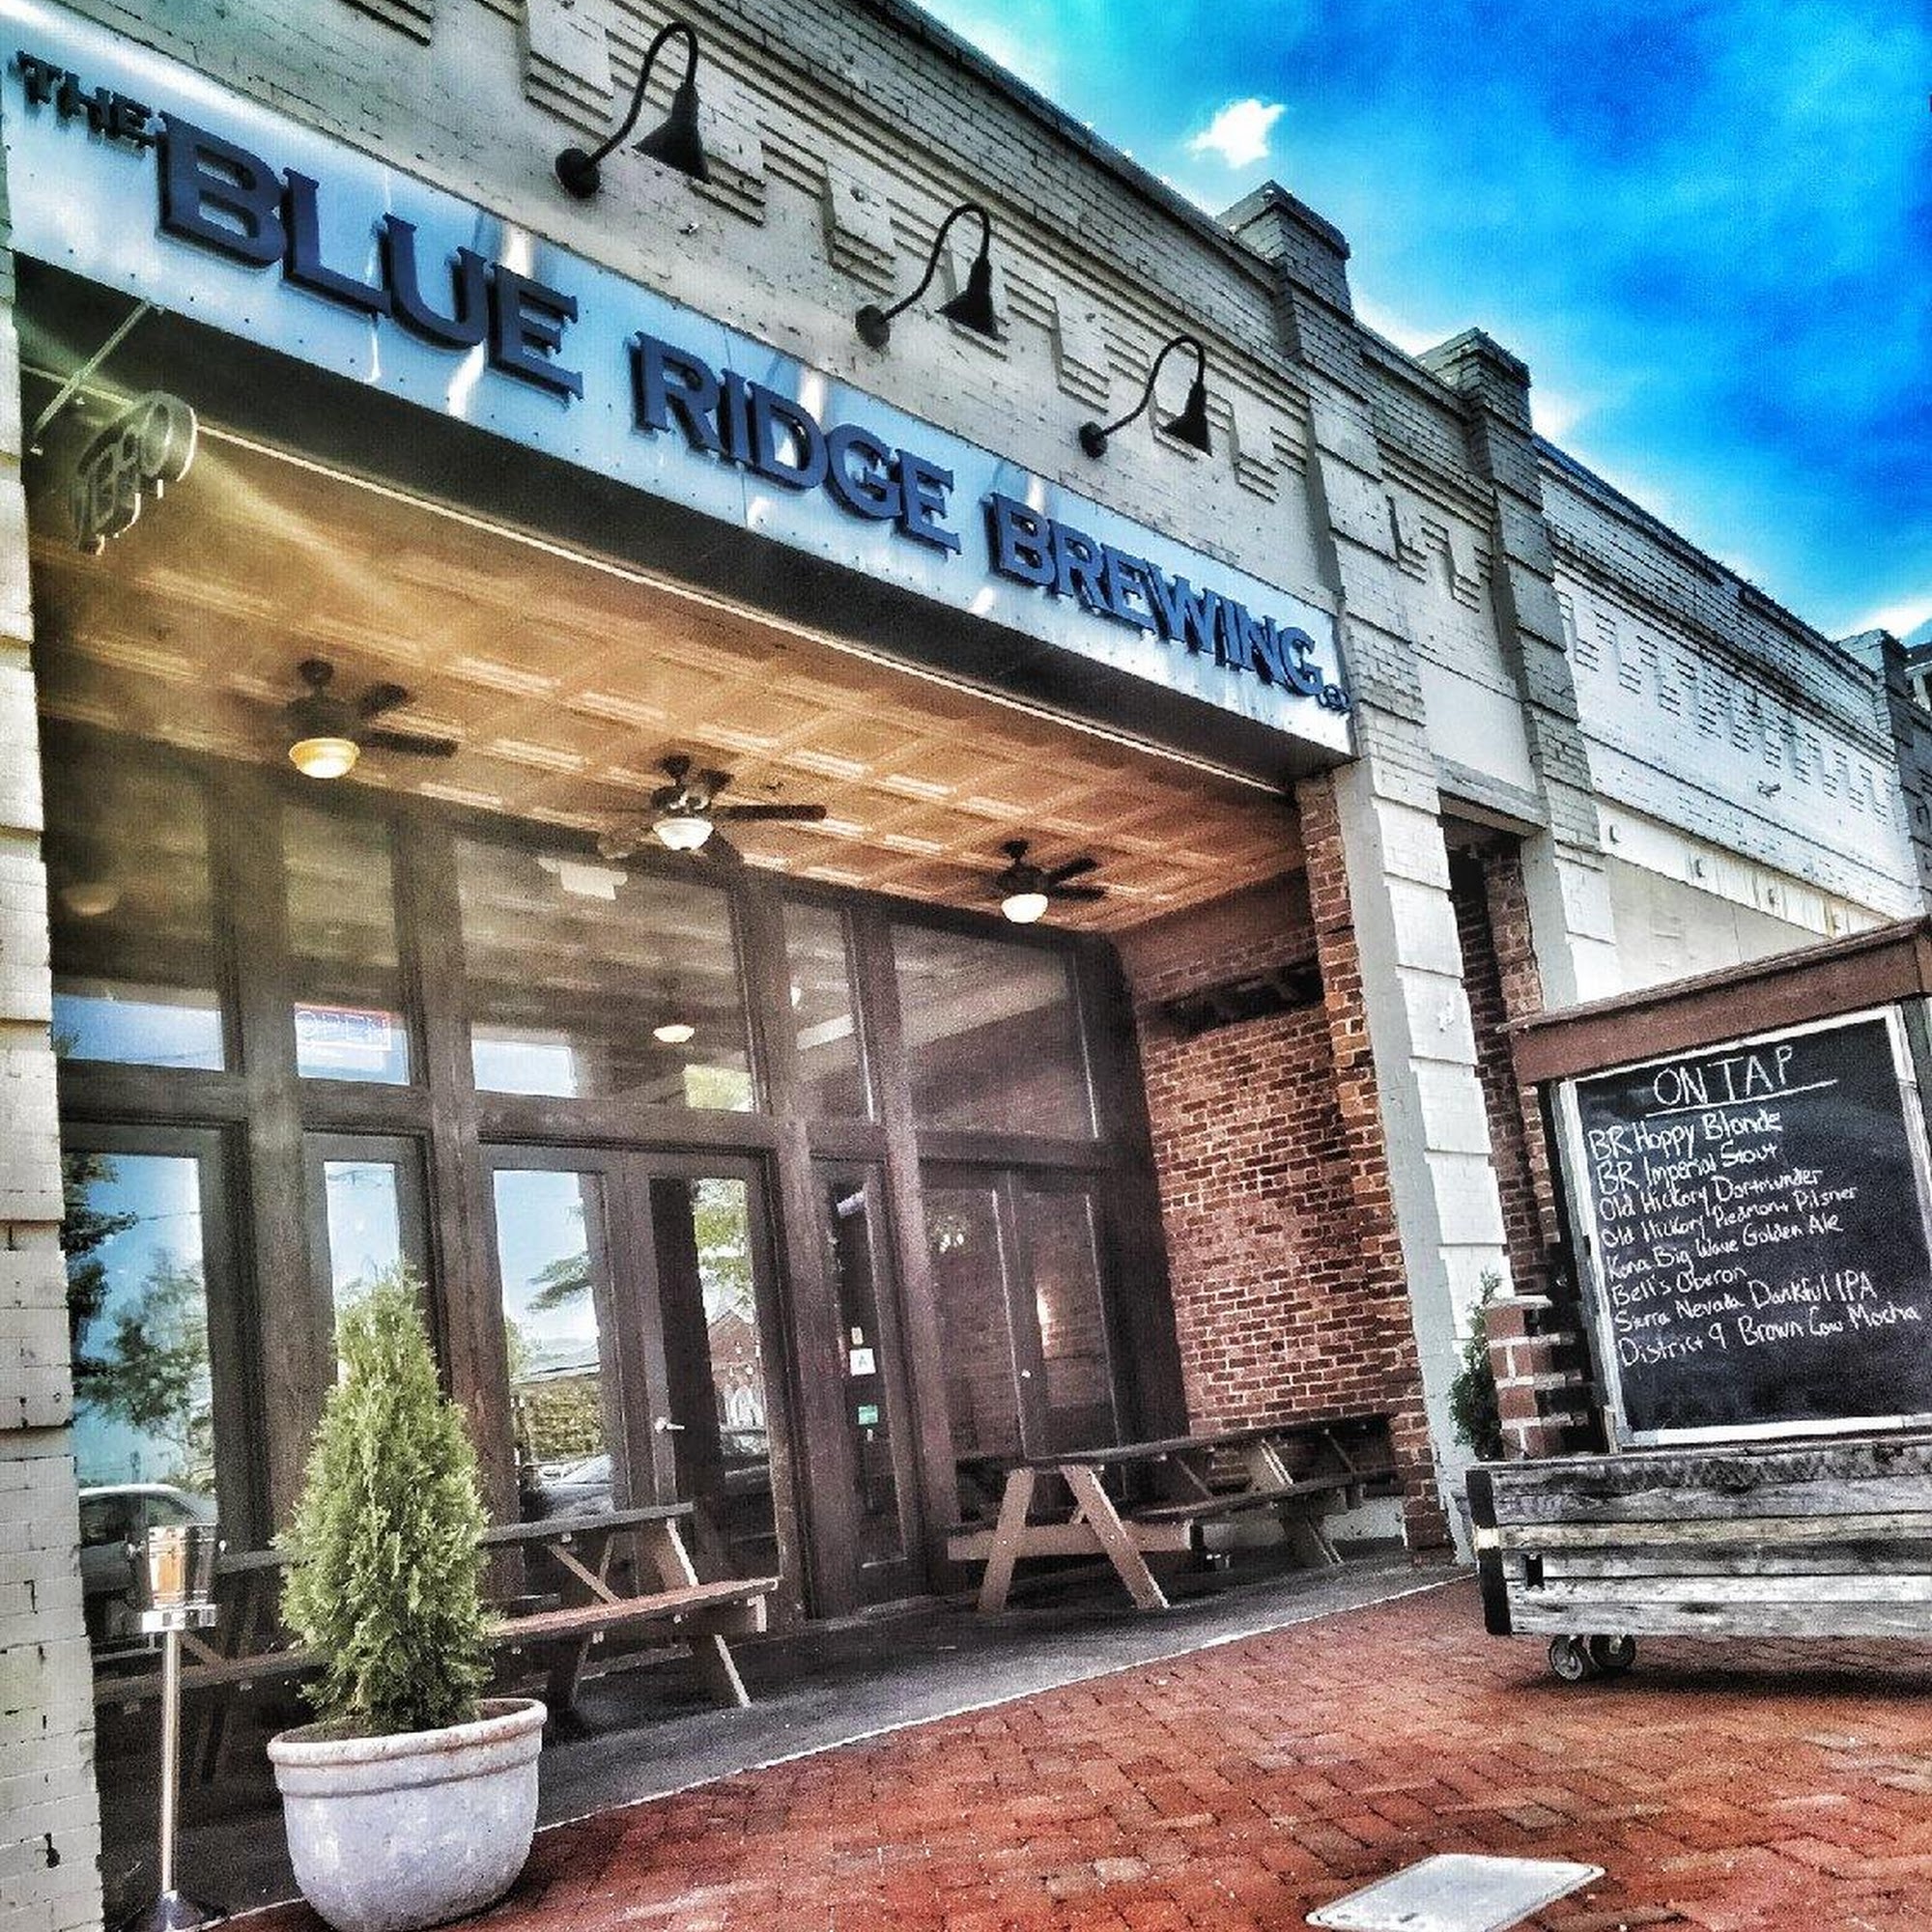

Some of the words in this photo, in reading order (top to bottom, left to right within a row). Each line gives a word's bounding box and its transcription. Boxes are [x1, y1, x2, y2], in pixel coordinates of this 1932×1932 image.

[15, 49, 156, 149] THE
[158, 111, 583, 401] BLUE
[632, 331, 961, 556] RIDGE
[982, 492, 1324, 696] BREWING
[1653, 1066, 1708, 1105] ON
[1706, 1044, 1793, 1101] TAP
[1588, 1124, 1634, 1160] BR
[1632, 1120, 1694, 1159] Hoppy
[1702, 1109, 1783, 1141] Blonde
[1596, 1159, 1639, 1196] BR
[1643, 1152, 1717, 1191] Imperial
[1719, 1138, 1778, 1168] Stout
[1600, 1193, 1636, 1221] Old
[1640, 1187, 1710, 1217] Hickory
[1601, 1226, 1634, 1248] Old
[1640, 1214, 1706, 1243] Hickory
[1712, 1201, 1789, 1229] Piedmont
[1792, 1186, 1858, 1212] Pilsner
[1606, 1253, 1652, 1282] Kona
[1652, 1245, 1694, 1279] Big
[1695, 1237, 1739, 1258] Wave
[1743, 1223, 1804, 1247] Golden
[1809, 1211, 1843, 1235] Ale
[1611, 1273, 1671, 1308] Bell's
[1676, 1266, 1747, 1293] Oberon
[1675, 1293, 1746, 1319] Nevada
[1747, 1274, 1832, 1310] Dankful
[1835, 1269, 1878, 1302] IPA
[1618, 1336, 1704, 1367] District
[1708, 1322, 1727, 1350] 9
[1738, 1315, 1804, 1347] Brown
[1808, 1306, 1844, 1337] Cow
[1846, 1301, 1921, 1330] Mocha
